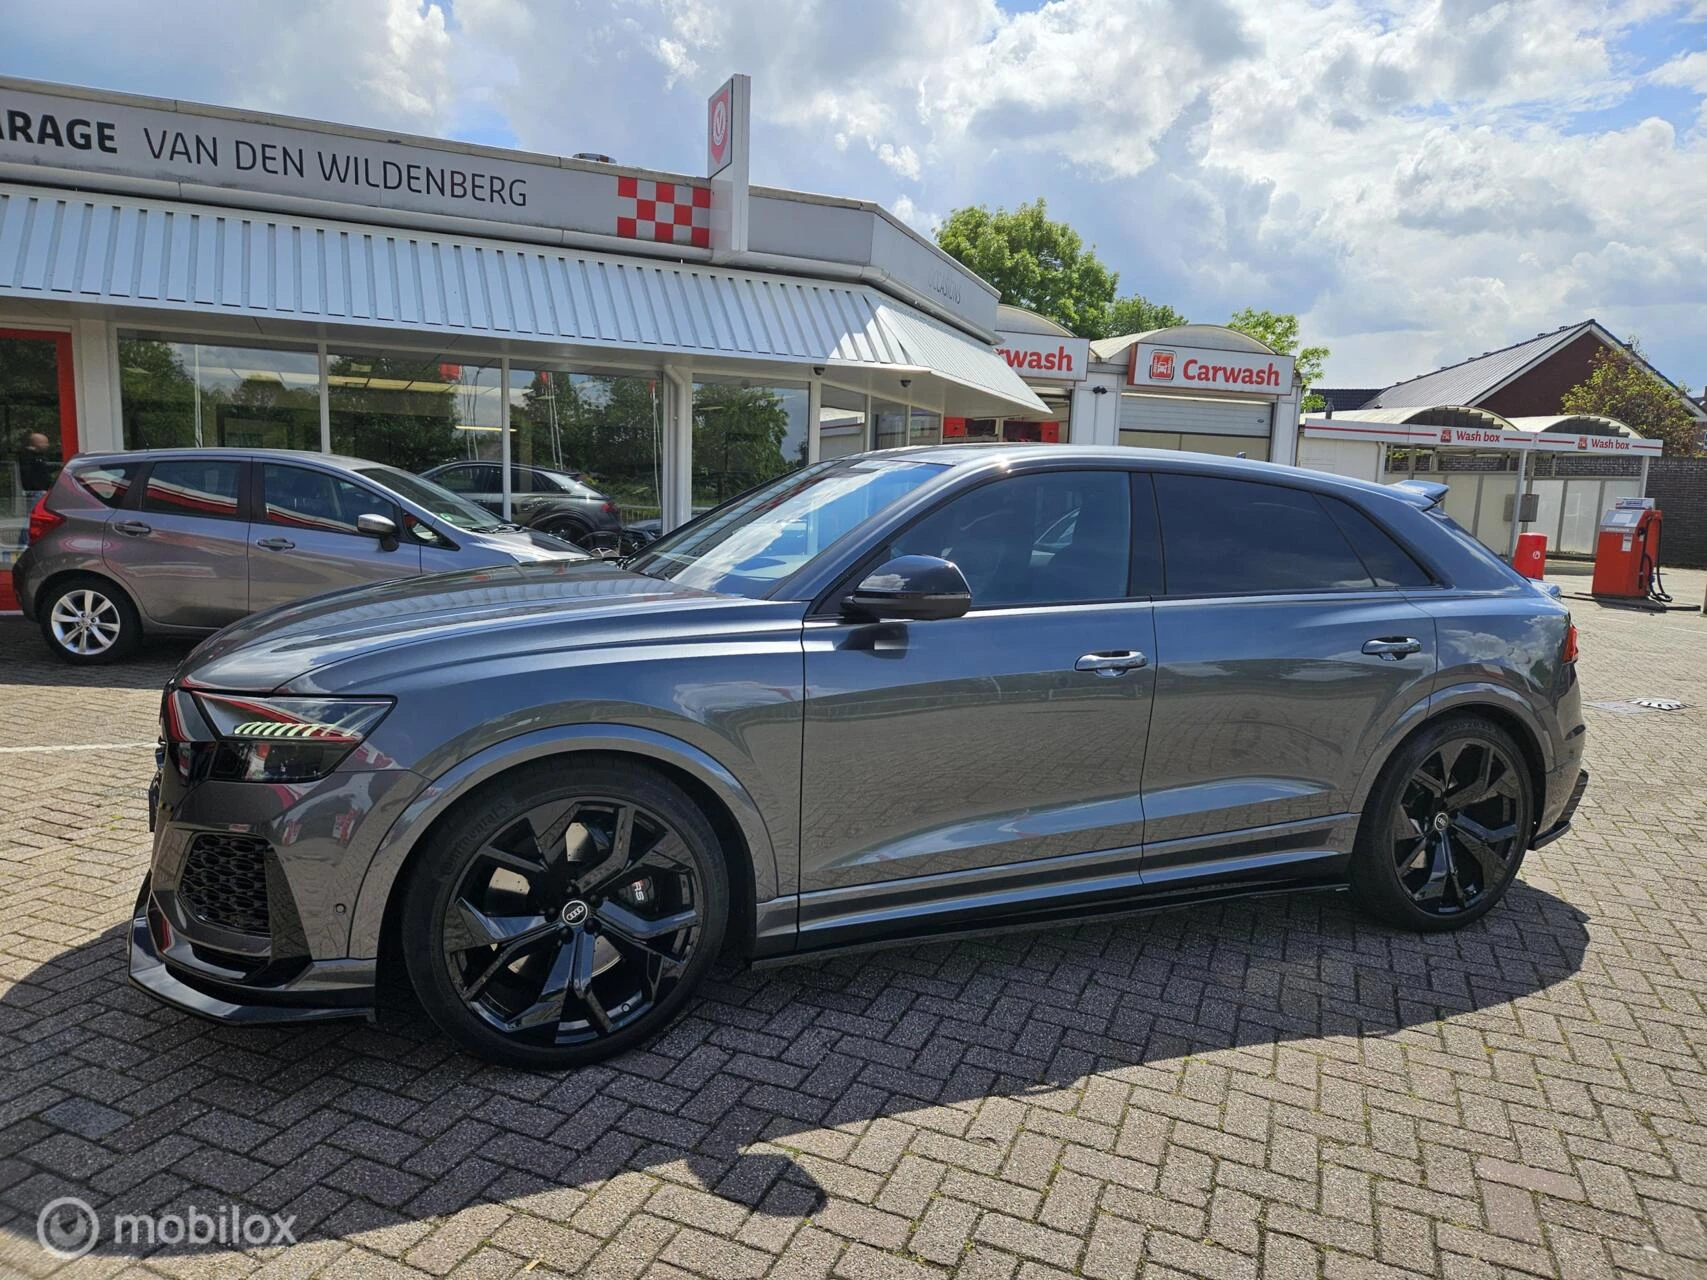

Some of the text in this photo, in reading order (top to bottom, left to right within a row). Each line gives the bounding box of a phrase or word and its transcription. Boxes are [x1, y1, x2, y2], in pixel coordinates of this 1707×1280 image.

[143, 127, 218, 167] VAN
[235, 139, 305, 178] DEN
[317, 151, 527, 207] WILDENBERG
[1183, 359, 1280, 386] Carwash
[1456, 430, 1500, 442] Wash box
[1591, 438, 1630, 450] Wash box
[632, 881, 645, 901] RS
